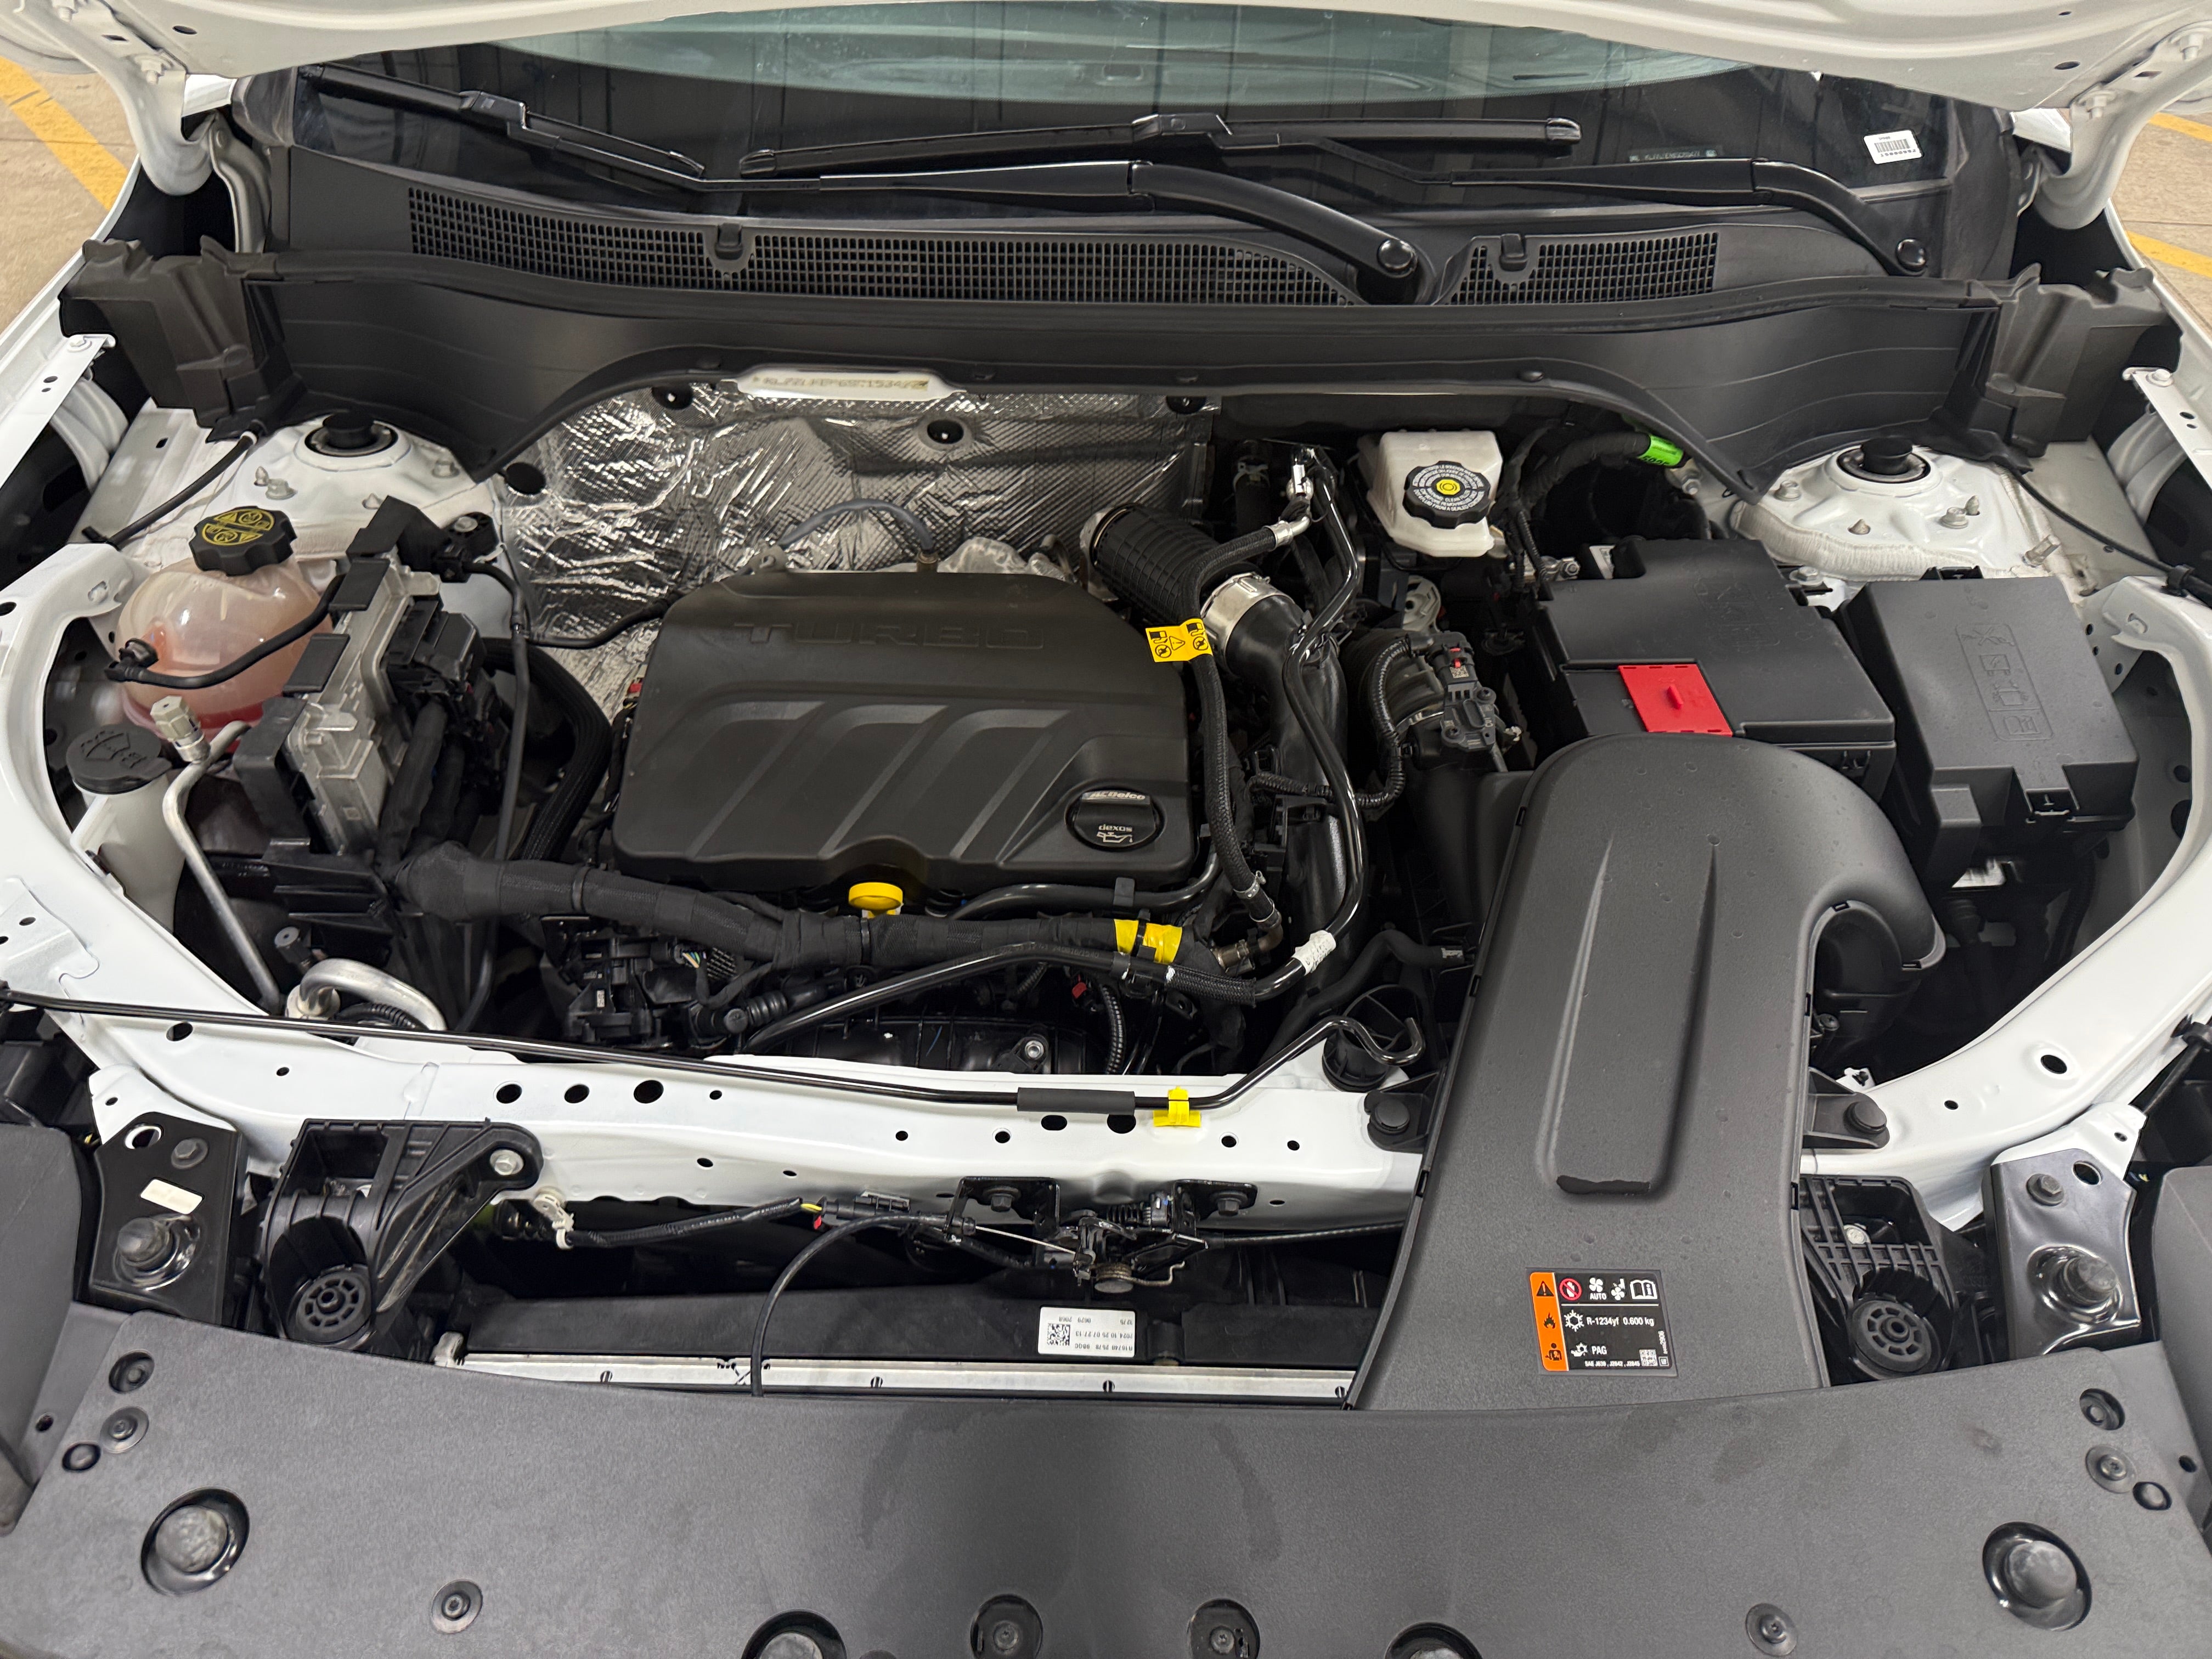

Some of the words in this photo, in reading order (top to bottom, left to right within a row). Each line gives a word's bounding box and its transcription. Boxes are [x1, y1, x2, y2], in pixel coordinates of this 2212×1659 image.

[733, 622, 1043, 650] TURBO
[1090, 791, 1146, 800] ACDelco
[1587, 1317, 1620, 1327] R-1234yf
[1623, 1317, 1643, 1325] 0.600
[1645, 1317, 1654, 1327] kg
[1592, 1346, 1607, 1355] PAG
